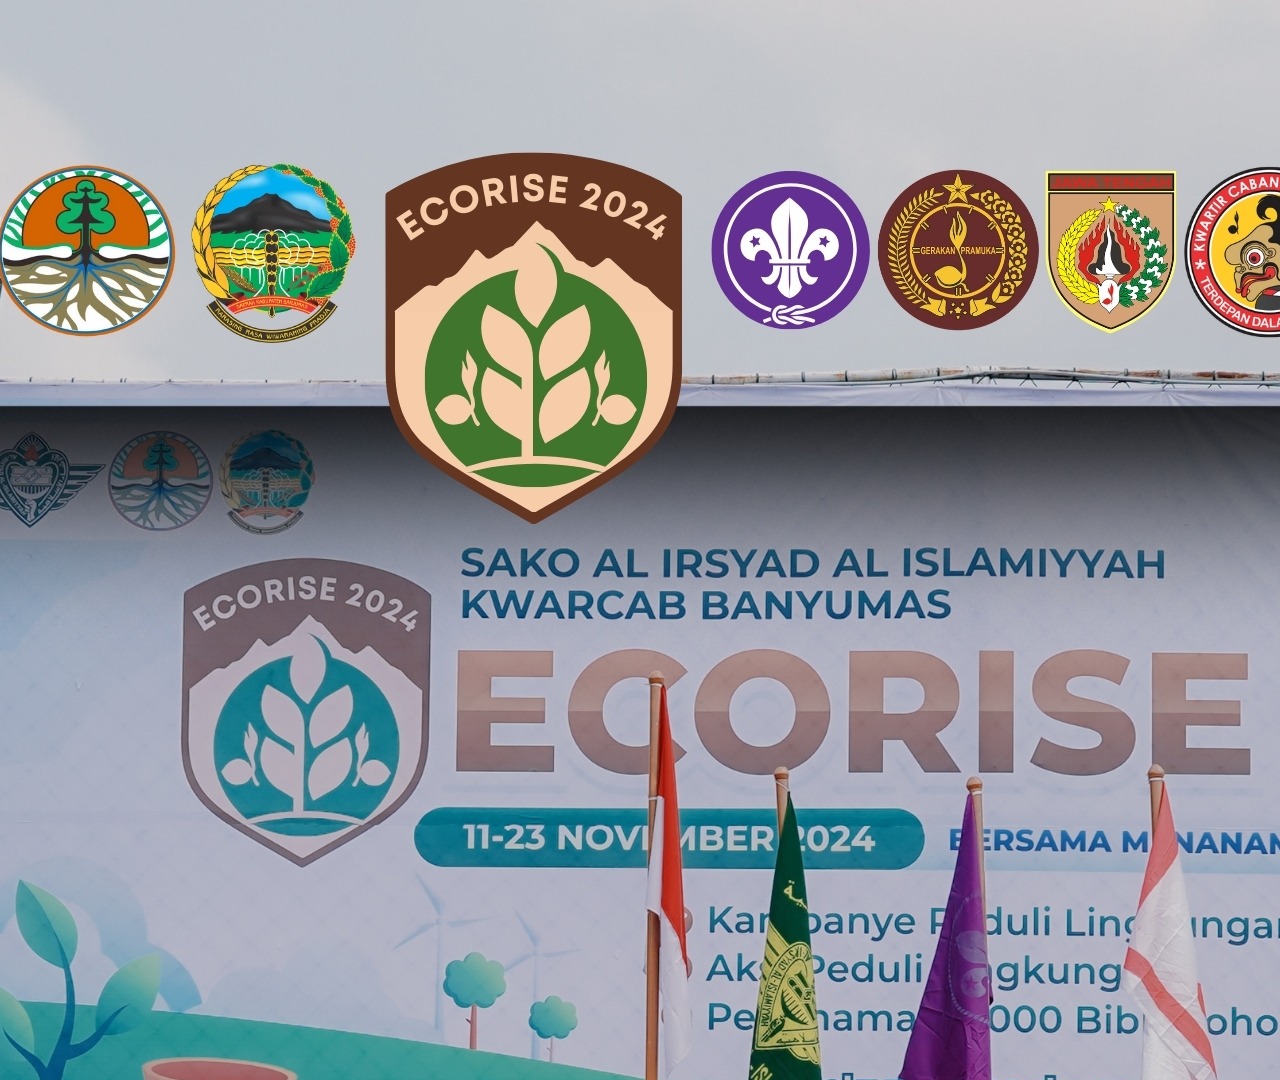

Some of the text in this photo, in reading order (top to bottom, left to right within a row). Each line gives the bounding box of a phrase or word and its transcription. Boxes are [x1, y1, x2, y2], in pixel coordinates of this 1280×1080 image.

[461, 547, 1165, 579] SAKO AL IRSYAD AL ISLAMIYYAH
[191, 575, 420, 632] ECORISE 2024
[462, 589, 952, 620] KWARCAB BANYUMAS
[455, 648, 1251, 776] ECORISE
[463, 824, 545, 850] 11-23
[708, 905, 916, 941] Kaanye
[930, 905, 1051, 936] Pduli
[708, 1002, 916, 1032] Peama
[990, 1004, 1062, 1033] 000
